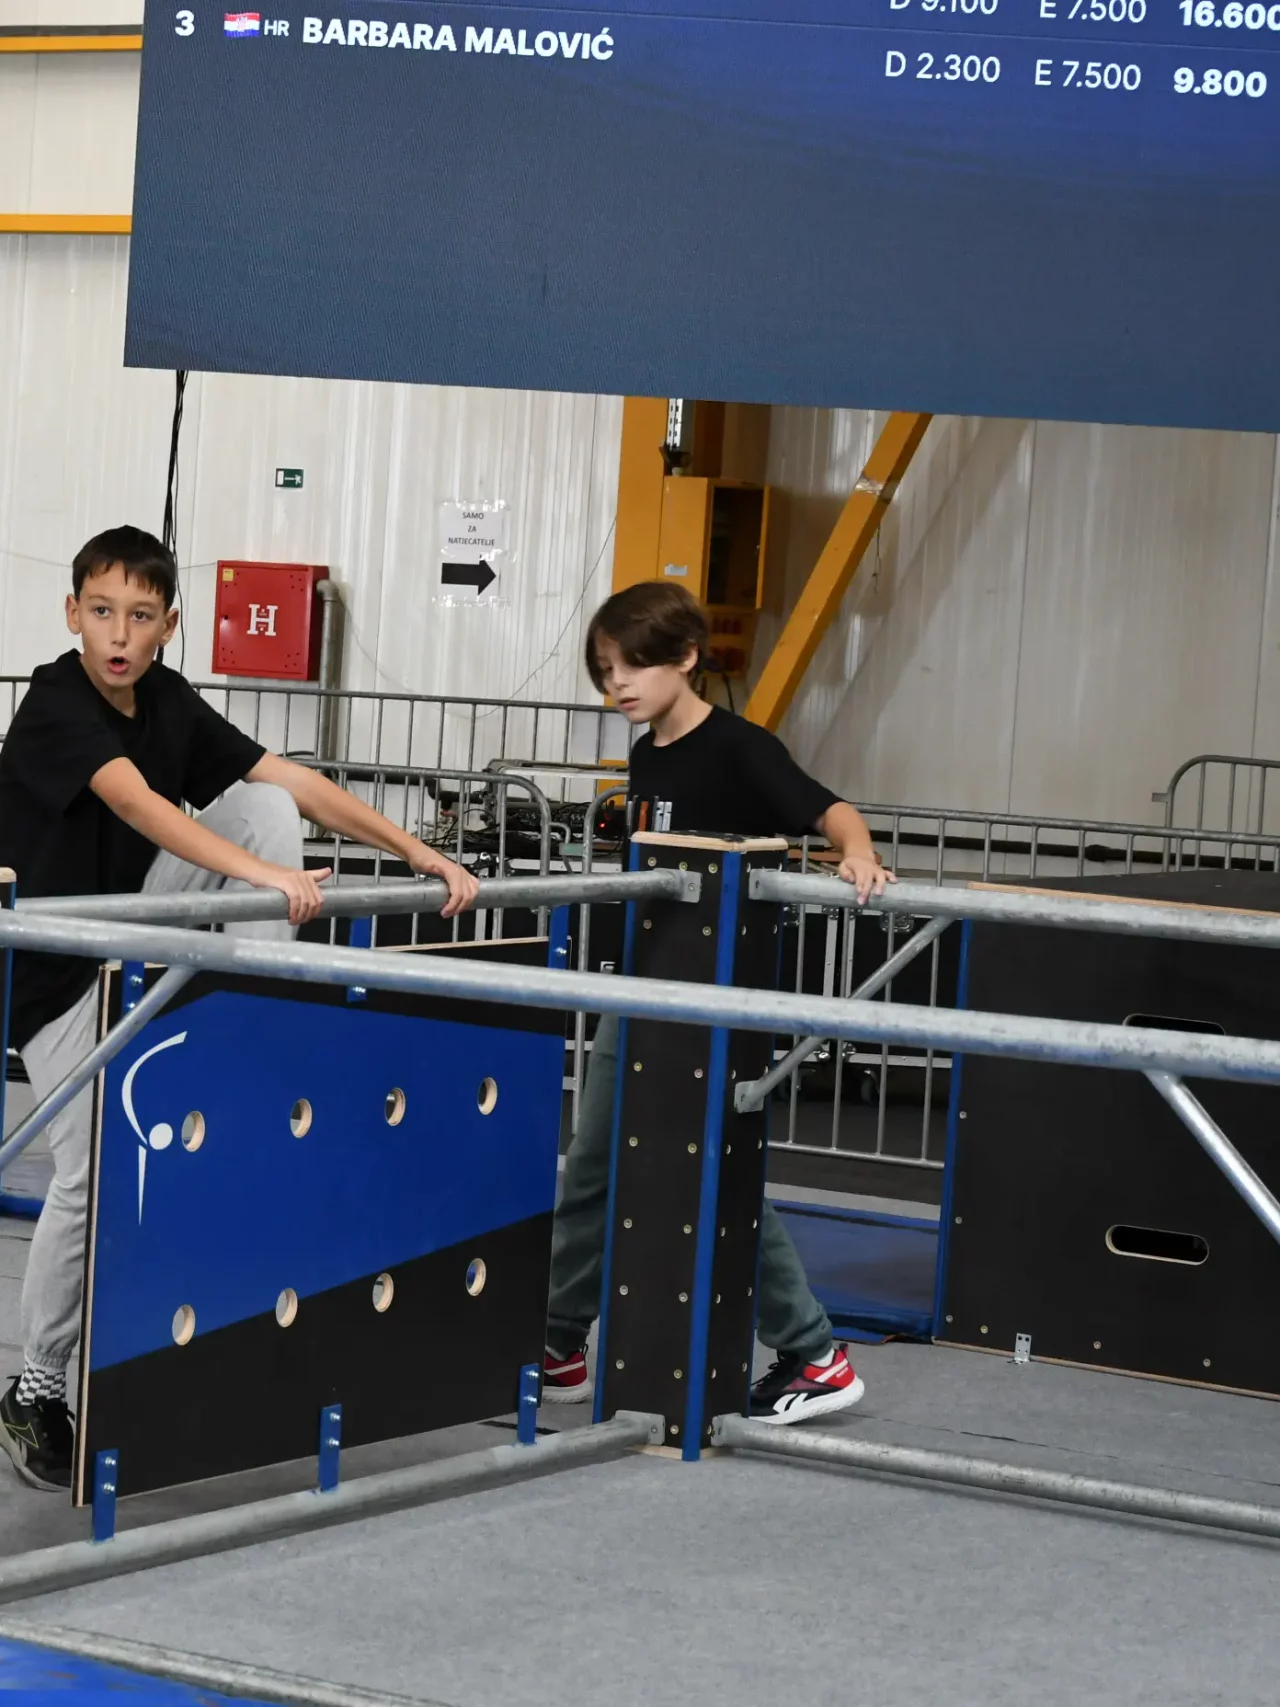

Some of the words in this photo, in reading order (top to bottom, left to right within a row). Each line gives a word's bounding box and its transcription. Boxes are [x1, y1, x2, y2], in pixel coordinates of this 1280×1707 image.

[1040, 0, 1057, 18] E
[1067, 0, 1147, 23] 7.500
[1179, 0, 1280, 31] 16.600
[175, 10, 195, 36] 3
[264, 19, 290, 37] HR
[302, 16, 457, 51] BARBARA
[464, 26, 614, 60] MALOVIĆ
[885, 50, 907, 77] D
[916, 52, 1001, 83] 2.300
[1034, 59, 1053, 86] E
[1062, 60, 1142, 91] 7.500
[1173, 67, 1267, 98] 9.800
[462, 512, 484, 520] SAMO
[467, 525, 477, 533] ZA
[448, 537, 495, 546] NATJECATELJE
[247, 604, 278, 637] H
